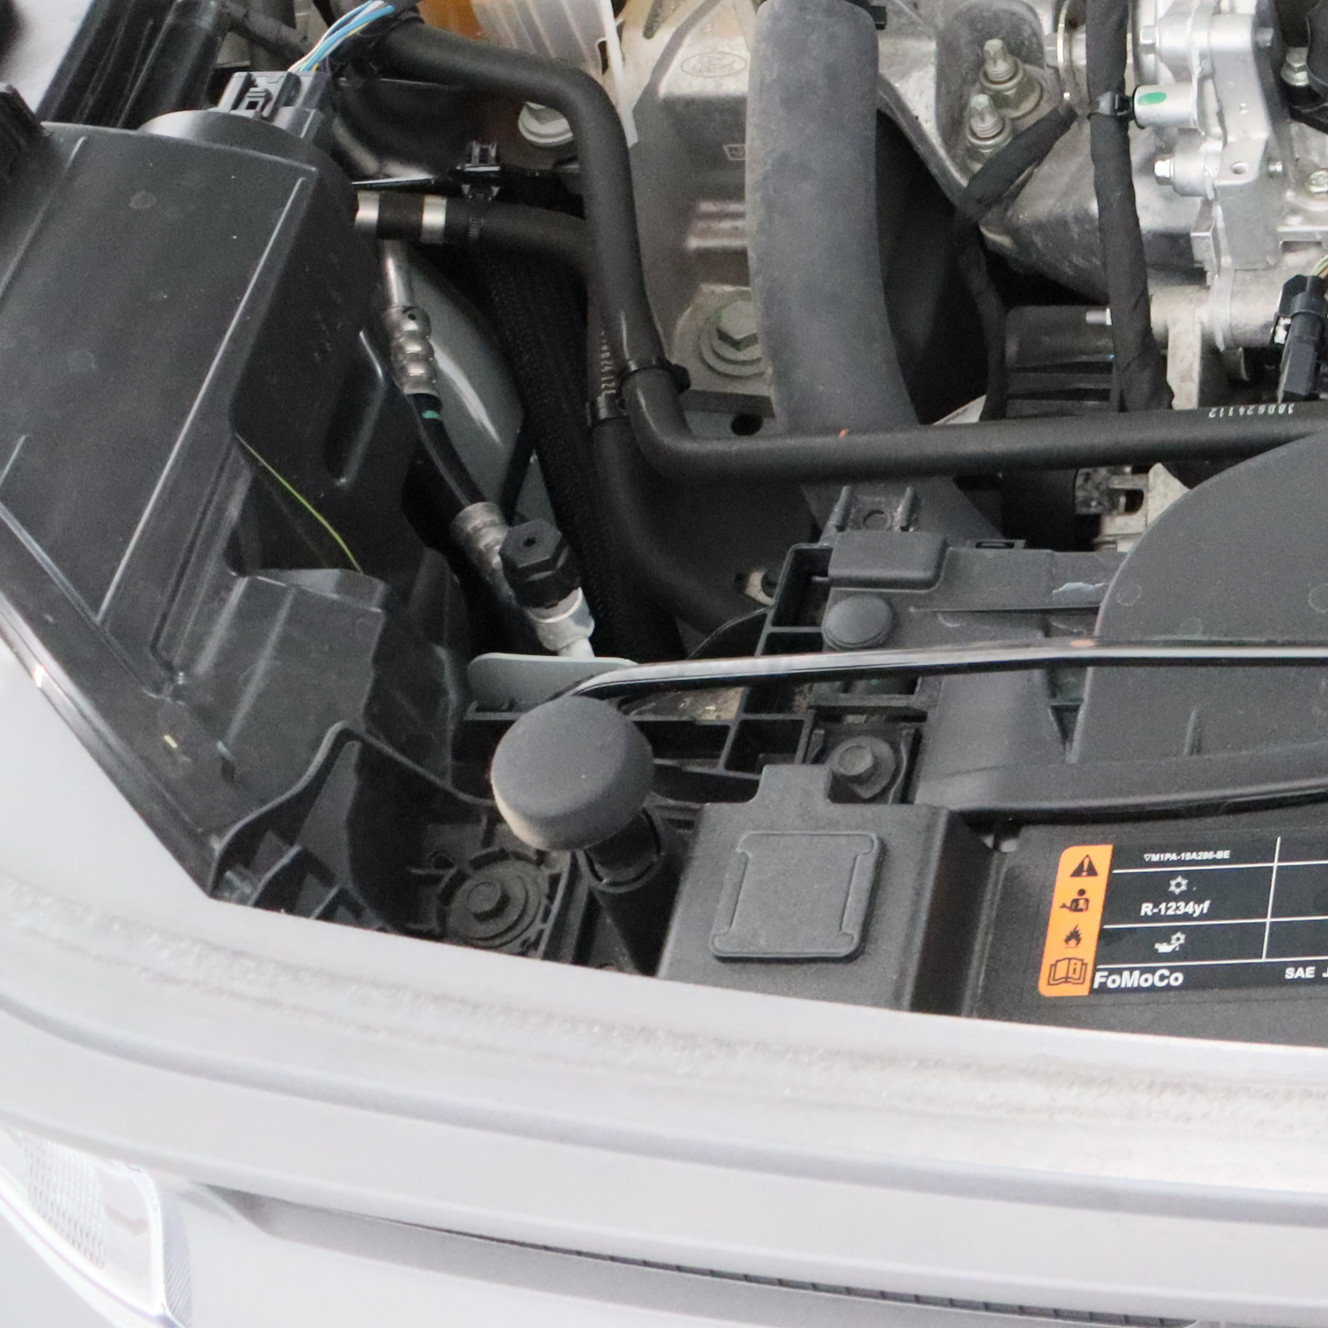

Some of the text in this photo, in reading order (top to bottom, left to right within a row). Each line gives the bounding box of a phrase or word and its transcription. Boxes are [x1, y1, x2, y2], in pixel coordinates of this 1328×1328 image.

[1140, 899, 1211, 917] R-1234yf
[1093, 968, 1184, 989] FoMoCo
[1284, 967, 1315, 979] SAE
